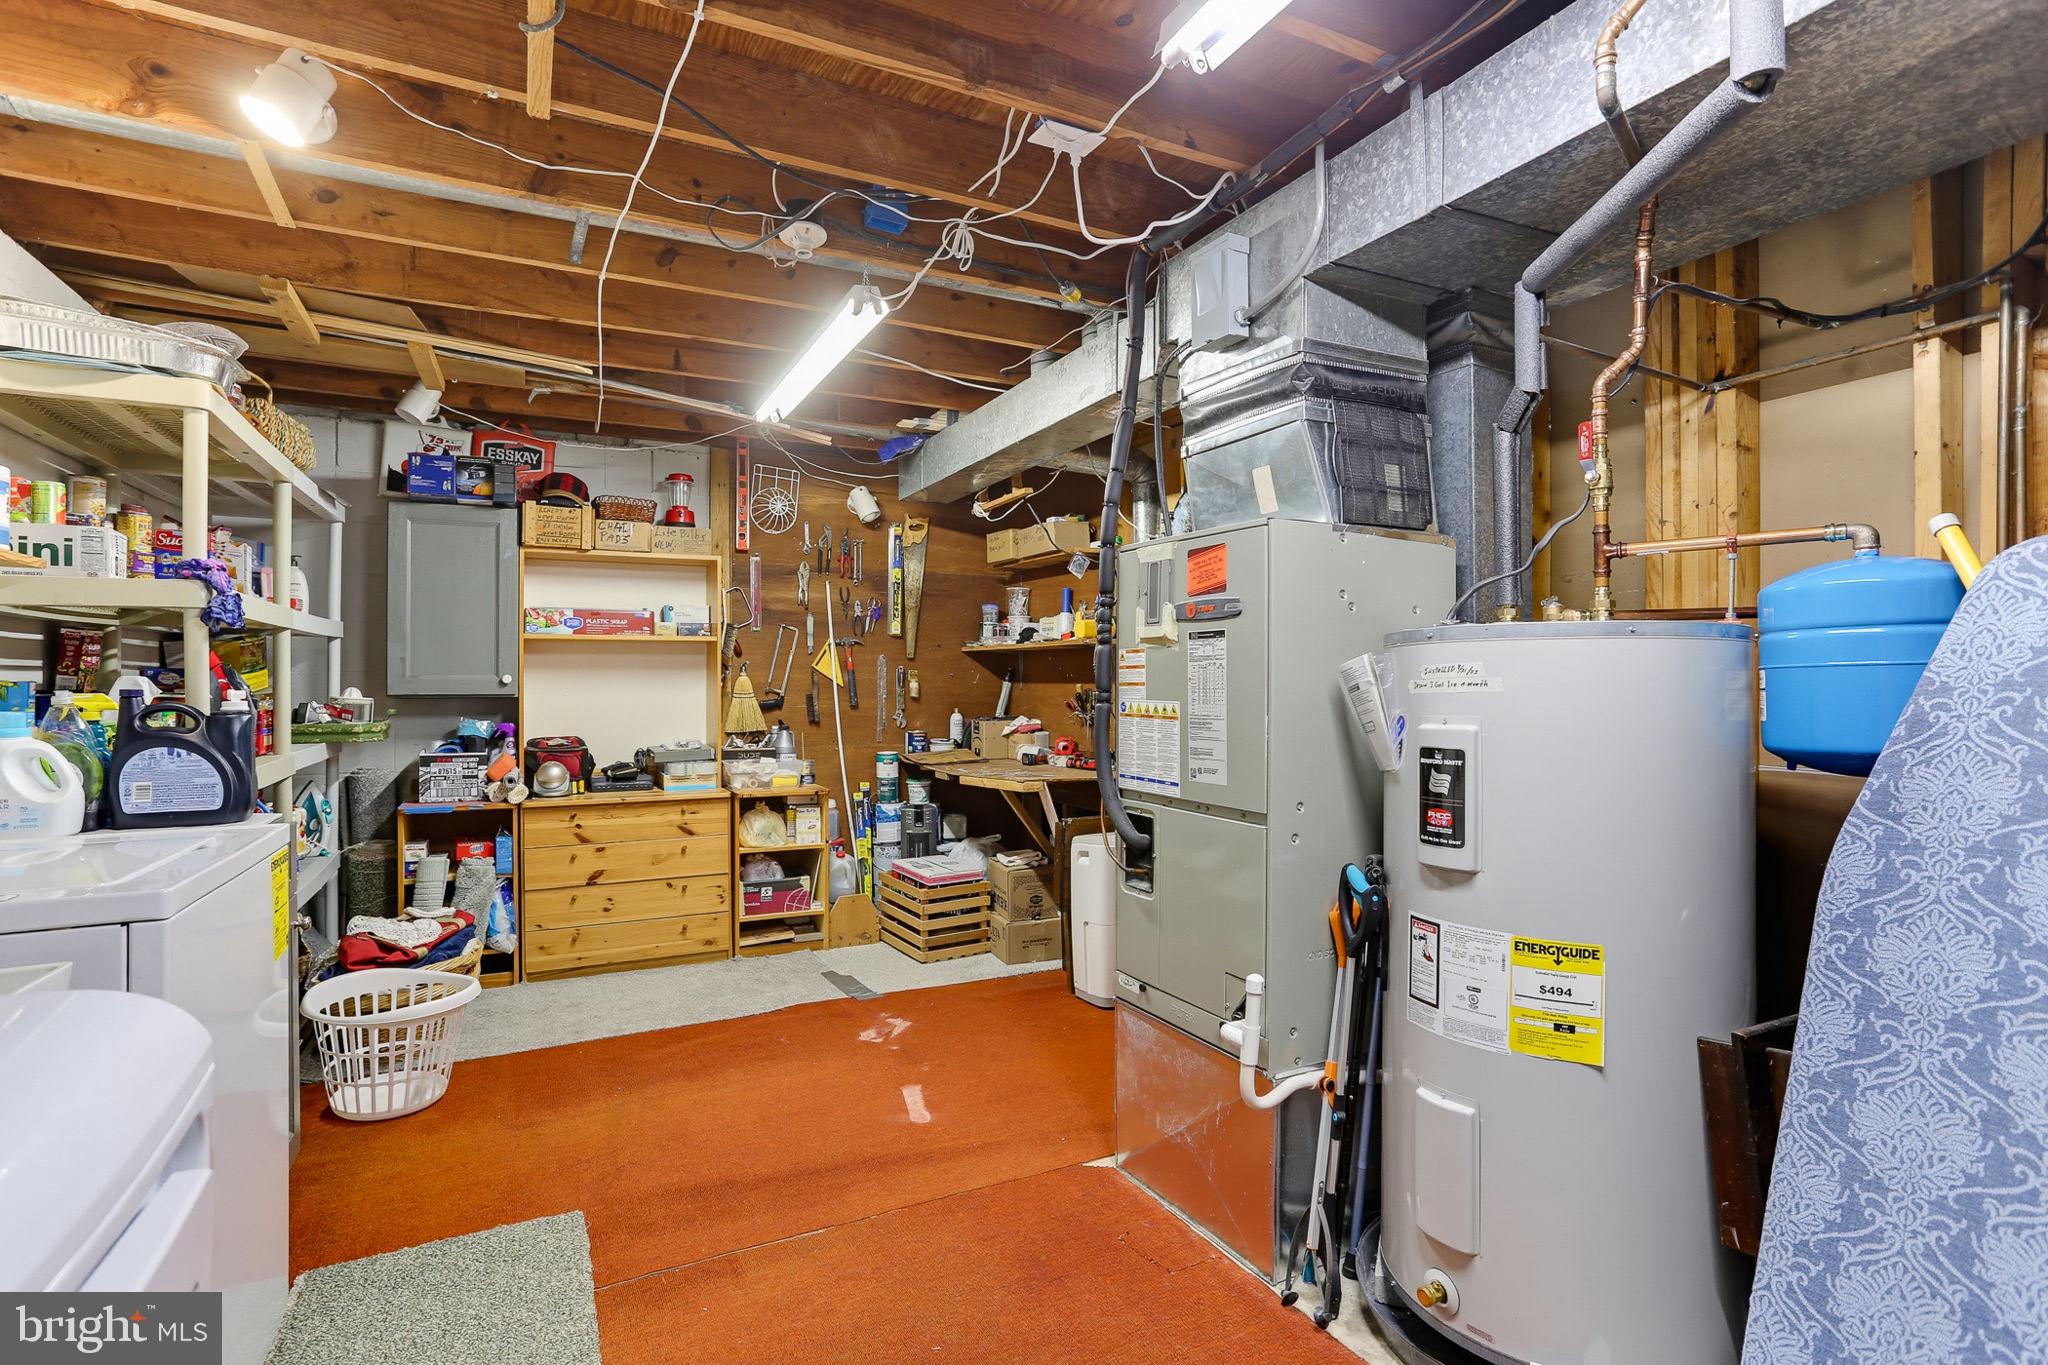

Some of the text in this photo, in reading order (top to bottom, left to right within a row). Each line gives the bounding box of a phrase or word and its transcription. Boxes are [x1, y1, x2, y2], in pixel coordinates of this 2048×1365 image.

[487, 446, 540, 465] ESSKAY
[1514, 941, 1600, 965] ENERGYGUIDE
[1539, 985, 1572, 998] $494
